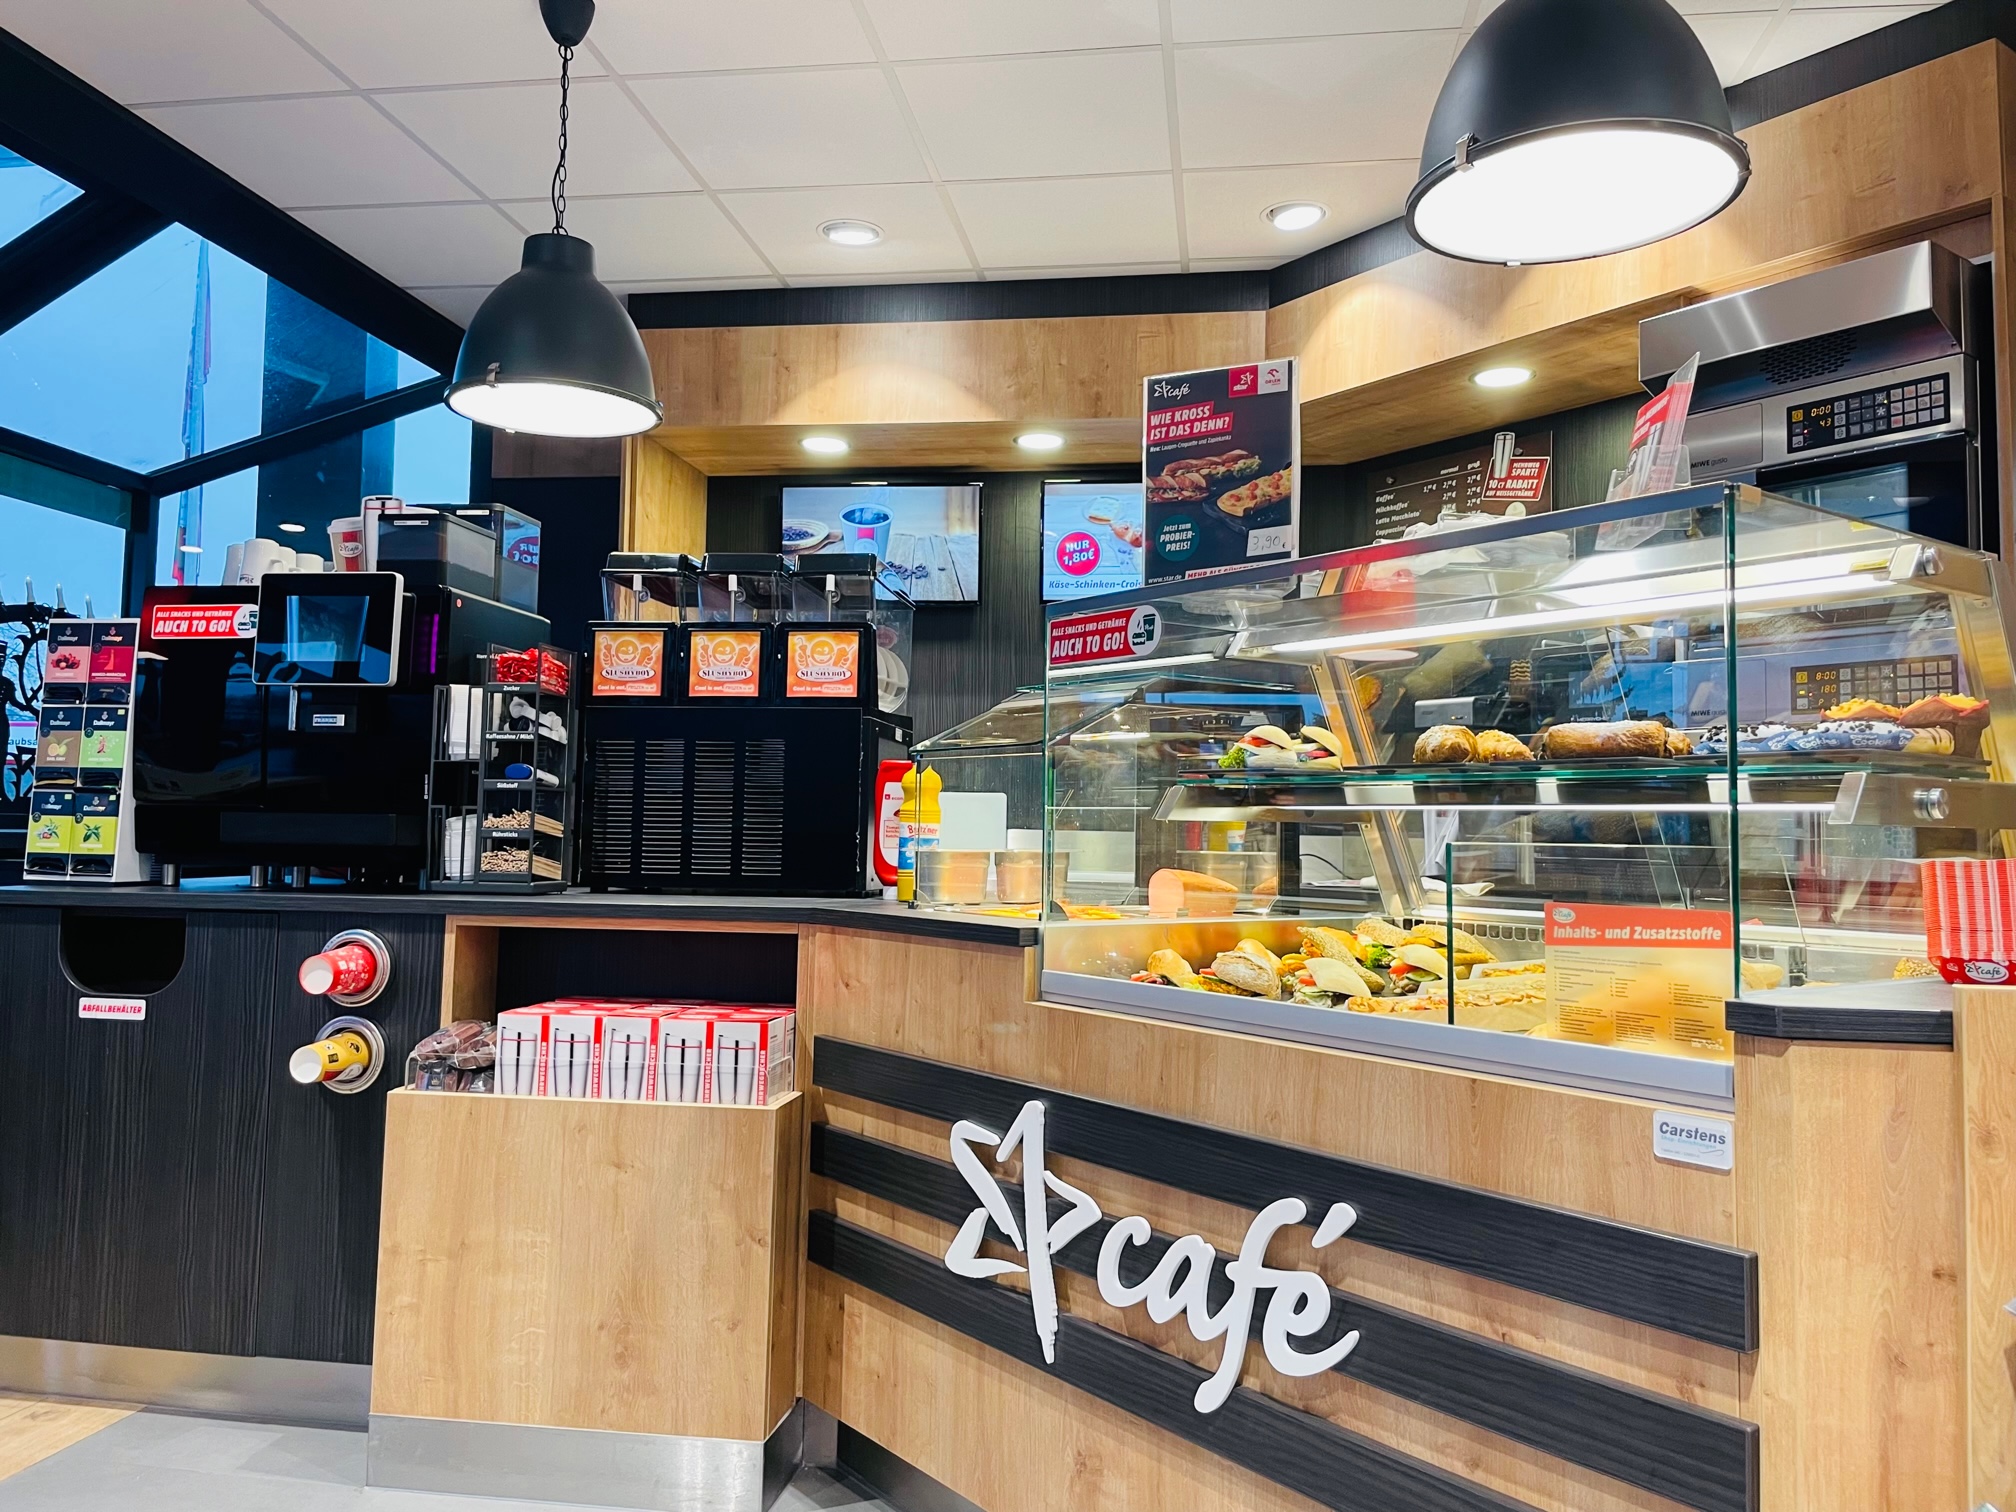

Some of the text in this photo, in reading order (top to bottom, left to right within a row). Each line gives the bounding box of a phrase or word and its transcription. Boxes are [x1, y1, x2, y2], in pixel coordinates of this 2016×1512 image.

[1168, 383, 1191, 399] café
[1151, 405, 1210, 426] WIE KROSS
[1811, 405, 1831, 417] 0:00
[1150, 417, 1230, 440] IST DAS DENN?
[1820, 418, 1831, 427] 43
[1511, 468, 1539, 476] SPART!
[1489, 480, 1498, 488] 10
[1506, 479, 1539, 488] RABATT
[1163, 524, 1178, 533] Jetzt
[1159, 532, 1196, 543] PROBIER-
[1065, 540, 1089, 552] NUR
[1165, 541, 1191, 552] PREIS!
[1063, 548, 1095, 566] 1,80€
[155, 620, 231, 633] AUCH TO GO!
[1052, 617, 1127, 636] ALLE SNACKS UND GETRÄNKE
[1052, 631, 1125, 658] AUCH TO GO!
[1815, 671, 1836, 680] 8:00
[1821, 685, 1837, 693] 180
[1553, 926, 1722, 941] Inhalts- und Zusatzstoffe
[1981, 967, 2001, 977] café
[82, 1004, 142, 1014] ABFALLBEHÄLTER
[539, 1042, 547, 1096] EHRWEGBECHER
[592, 1043, 601, 1098] EHRWEGBECHER
[647, 1045, 657, 1100] EHRWEGBECHER
[703, 1049, 712, 1103] EHRWEGBECHER
[757, 1050, 766, 1105] EHRWEGBECHER
[1659, 1122, 1726, 1145] Carstens
[1097, 1197, 1360, 1414] café
